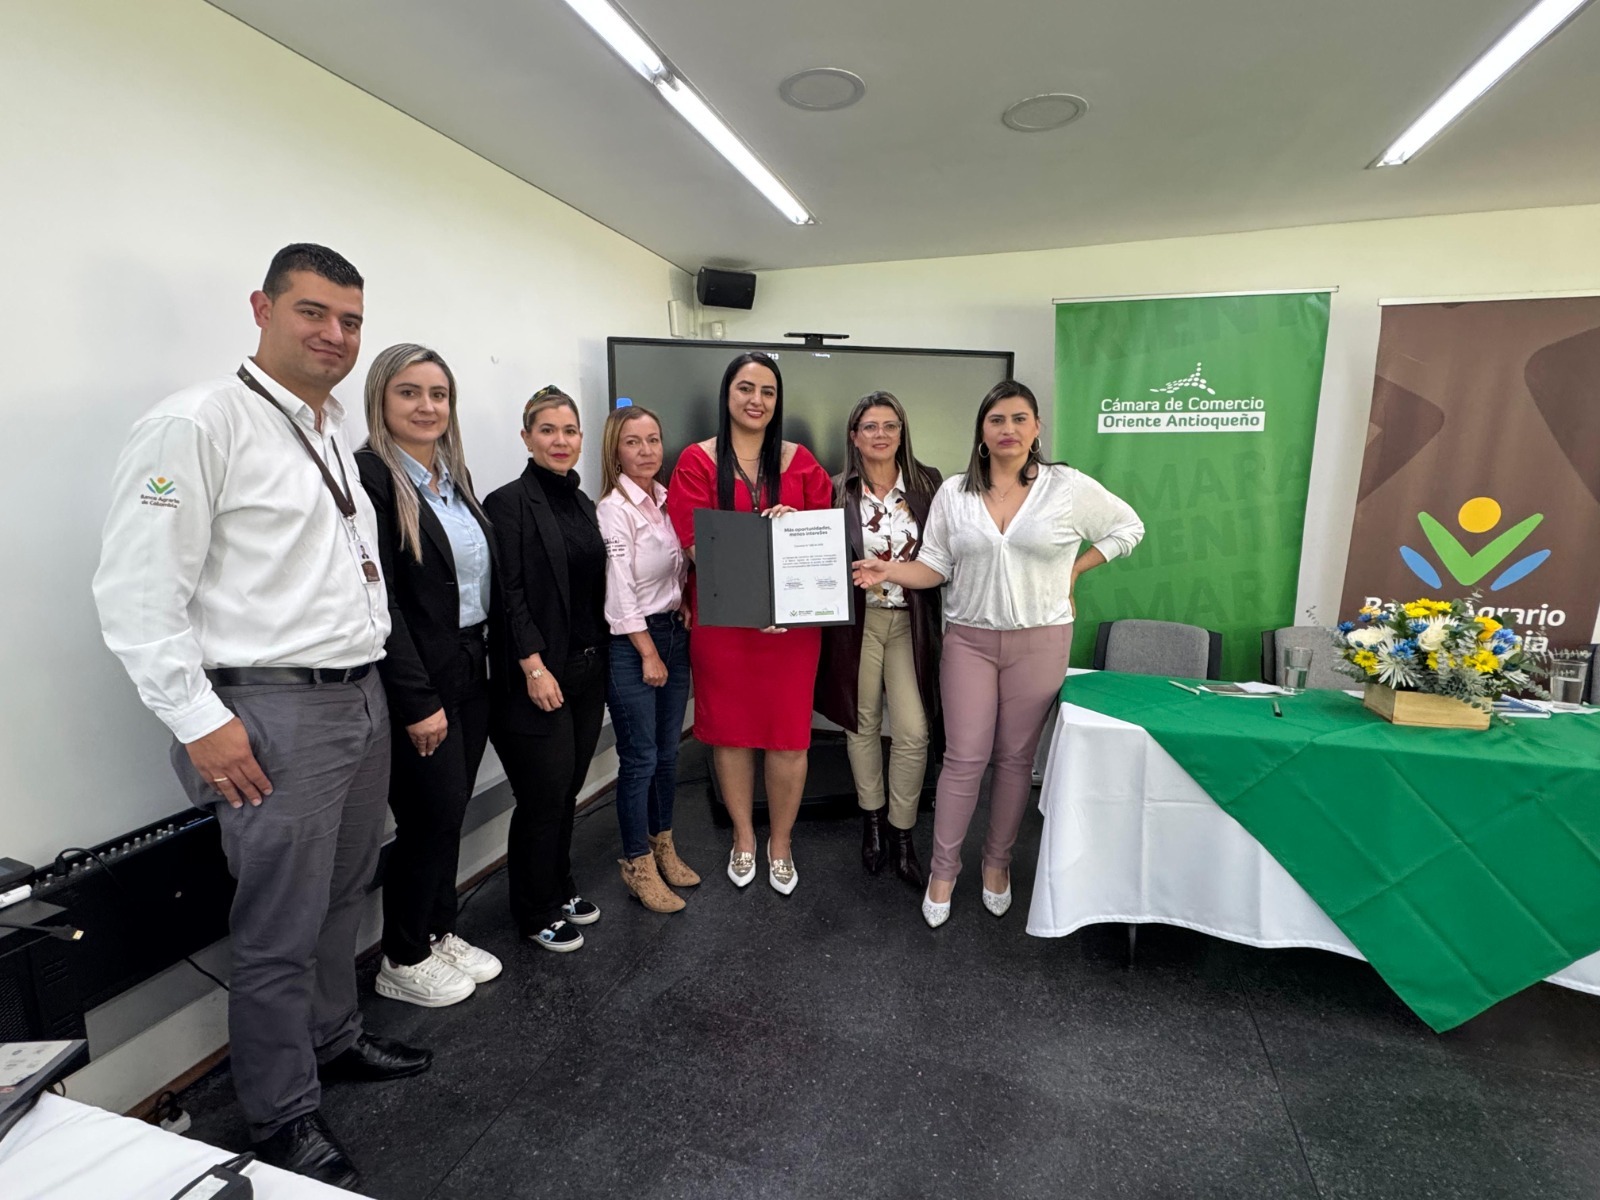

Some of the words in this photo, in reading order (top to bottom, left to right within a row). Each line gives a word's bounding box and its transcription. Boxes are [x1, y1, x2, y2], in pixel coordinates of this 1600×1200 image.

[1101, 398, 1160, 412] Cámara
[1165, 397, 1183, 411] de
[1188, 396, 1264, 410] Comercio
[1103, 415, 1161, 428] Oriente
[1166, 413, 1260, 430] Antioqueño
